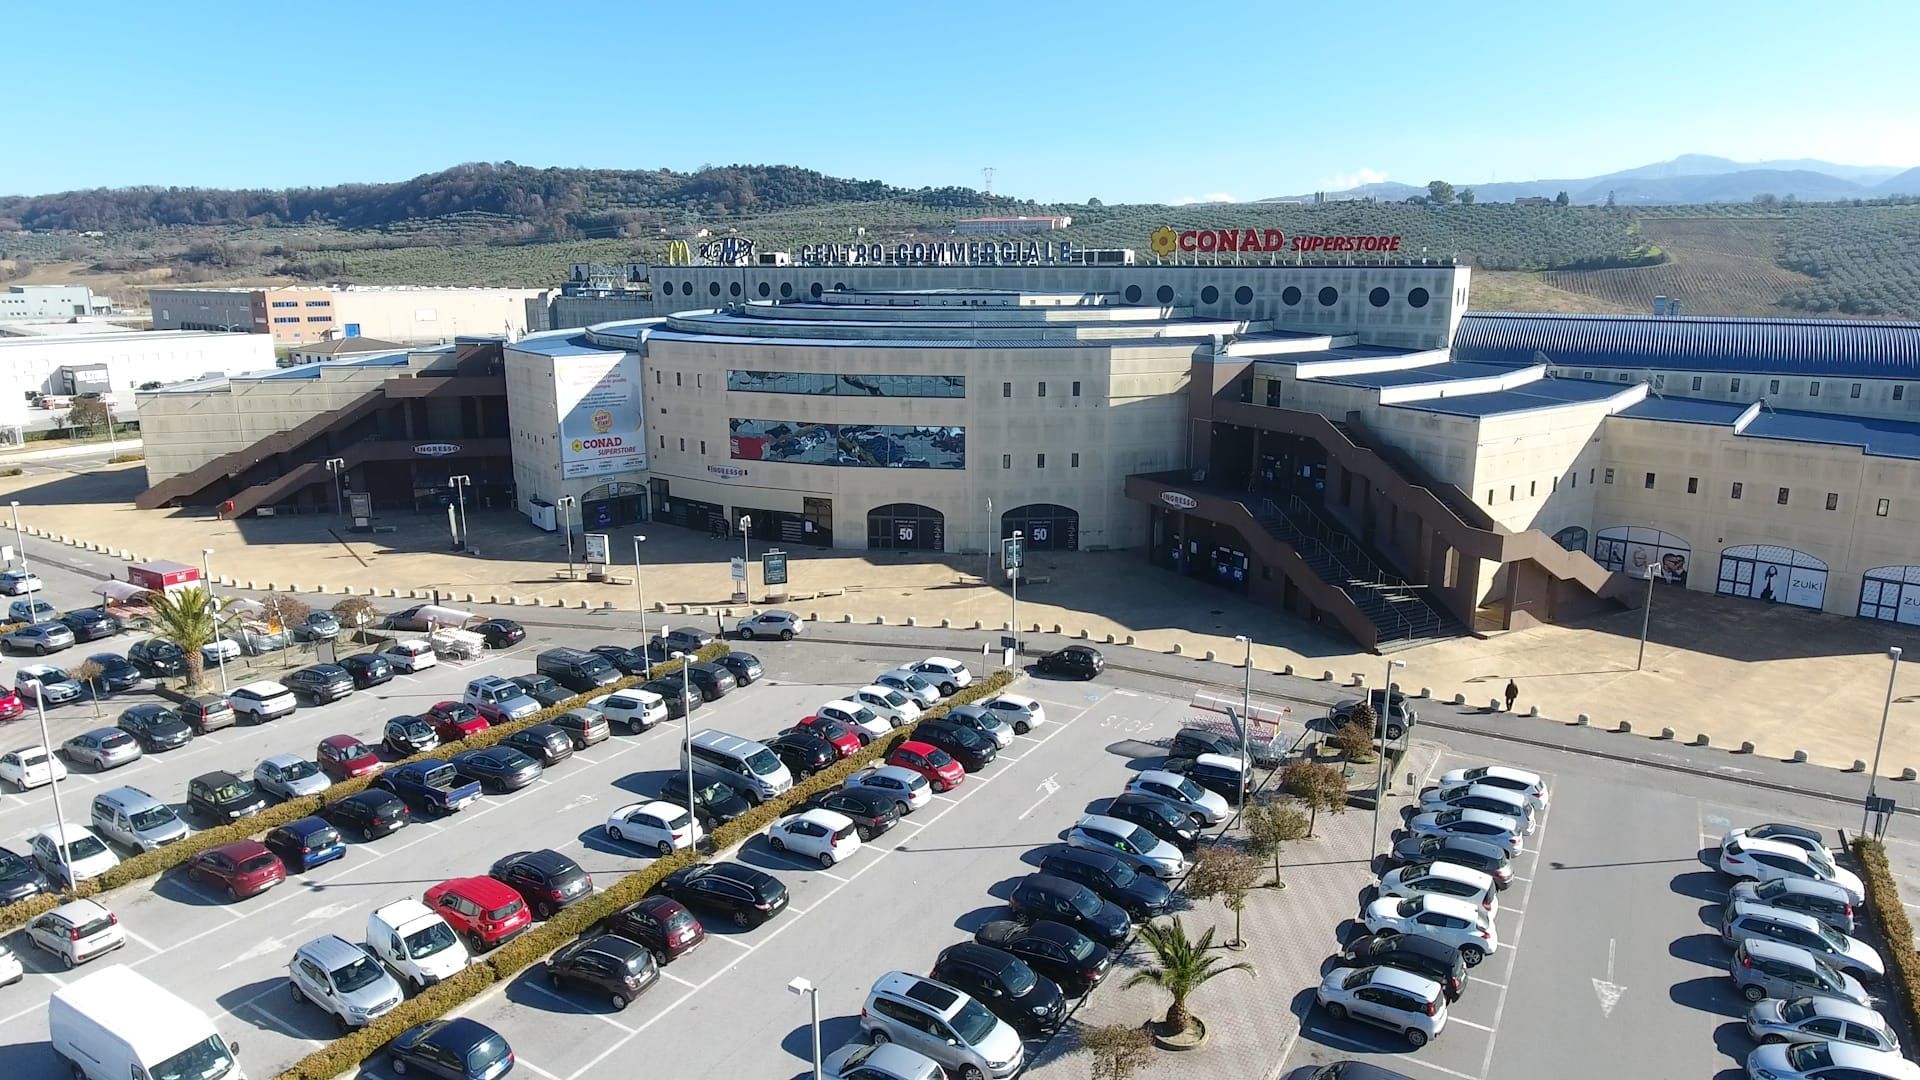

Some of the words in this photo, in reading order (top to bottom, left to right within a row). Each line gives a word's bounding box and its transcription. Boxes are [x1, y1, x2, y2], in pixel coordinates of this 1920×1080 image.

[1180, 229, 1285, 252] CONAD
[1291, 235, 1401, 252] SUPERSTORE
[801, 244, 883, 262] CENTRO
[898, 242, 1072, 262] COMMERCIALE
[416, 445, 458, 453] INGRESSO
[583, 437, 622, 449] CONAD
[598, 446, 636, 456] SUPERSTORE
[1162, 493, 1196, 507] INGRESSO
[899, 527, 913, 541] 50
[1033, 528, 1047, 541] 50
